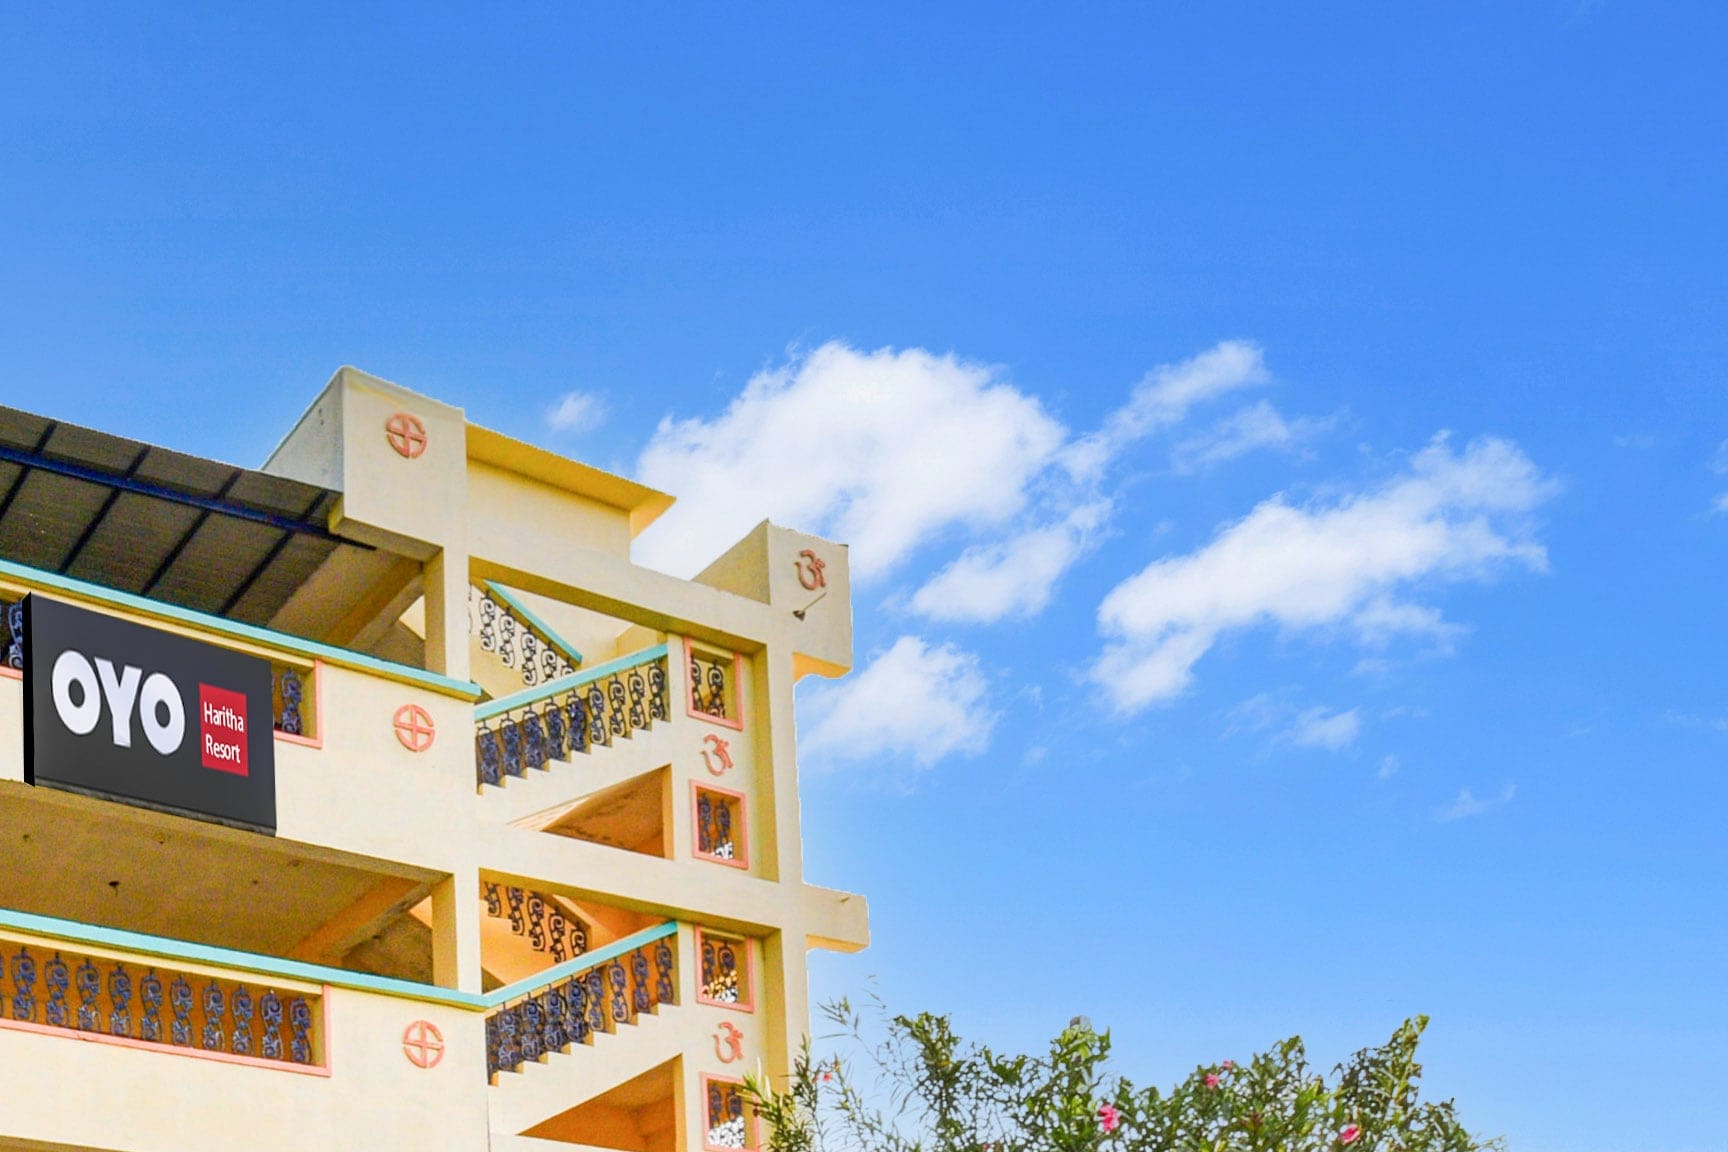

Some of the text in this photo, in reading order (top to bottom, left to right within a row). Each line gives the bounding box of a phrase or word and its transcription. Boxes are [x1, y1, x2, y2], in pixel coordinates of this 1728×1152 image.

[52, 649, 185, 755] OYO
[203, 701, 244, 732] Haritha
[205, 734, 240, 764] Resort
